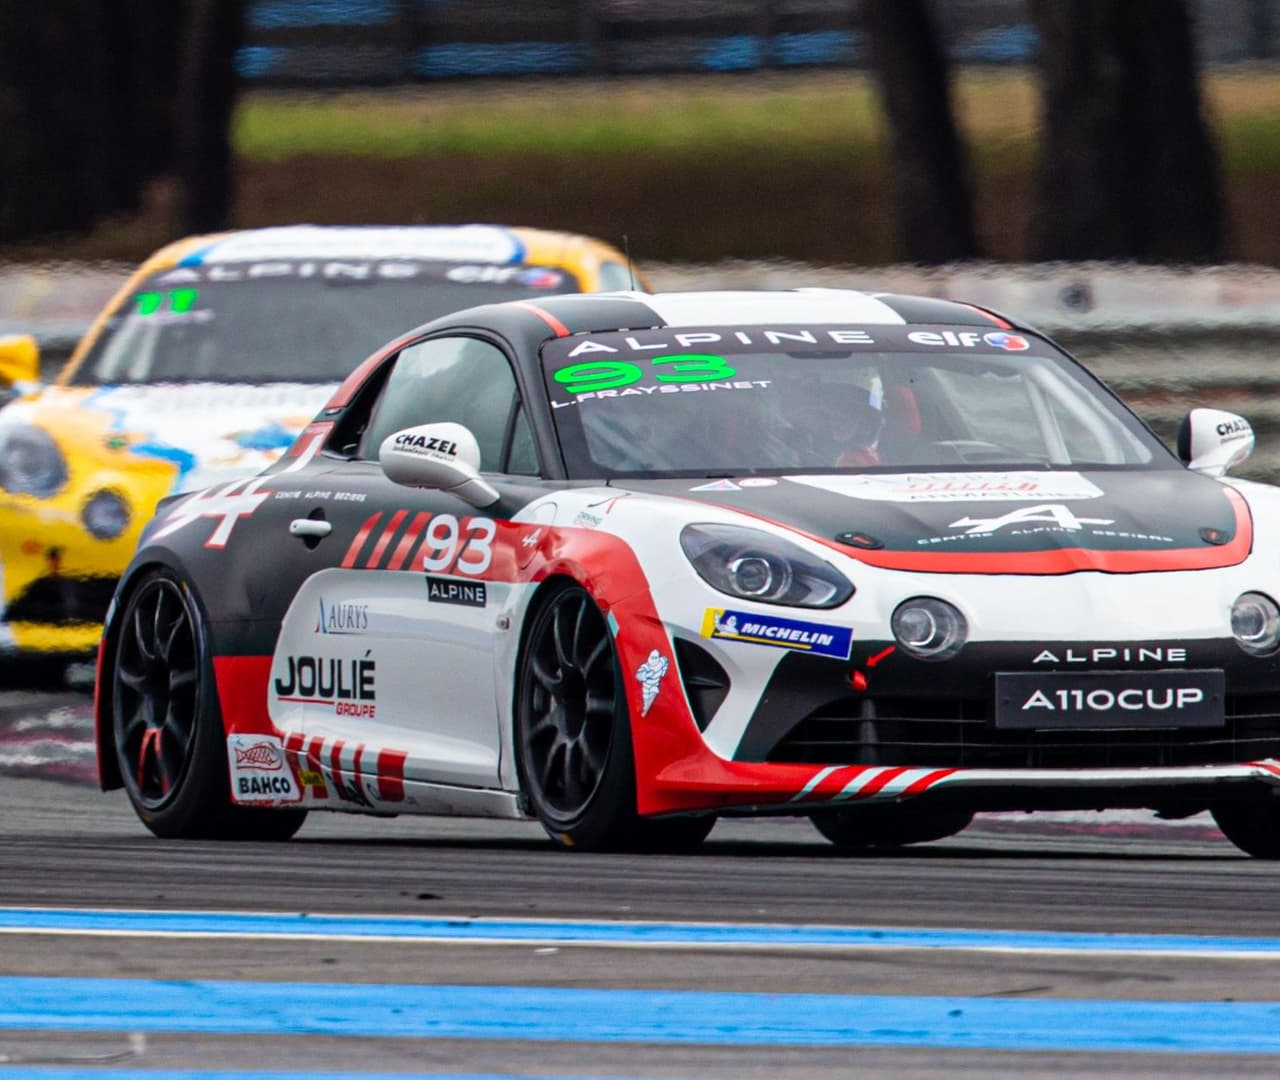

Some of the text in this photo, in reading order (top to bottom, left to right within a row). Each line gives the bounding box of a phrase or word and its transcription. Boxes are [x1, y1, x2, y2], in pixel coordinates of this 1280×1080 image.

[157, 261, 522, 283] ALPINE elf
[135, 288, 199, 316] 11
[568, 330, 981, 357] ALPINE elf
[554, 354, 737, 394] 93
[551, 380, 772, 409] L.FRAYSSINET
[395, 434, 457, 456] CHAZEL
[423, 513, 497, 575] 93
[917, 527, 1174, 545] CENTRE ALPINE BEZIERS
[430, 583, 484, 602] ALPINE
[741, 622, 834, 646] MICHELIN
[1032, 648, 1187, 663] ALPINE
[274, 648, 376, 700] JOULIÉ
[336, 702, 376, 718] GROUPE
[1022, 688, 1204, 711] A110CUP
[238, 776, 291, 794] BAHCO
